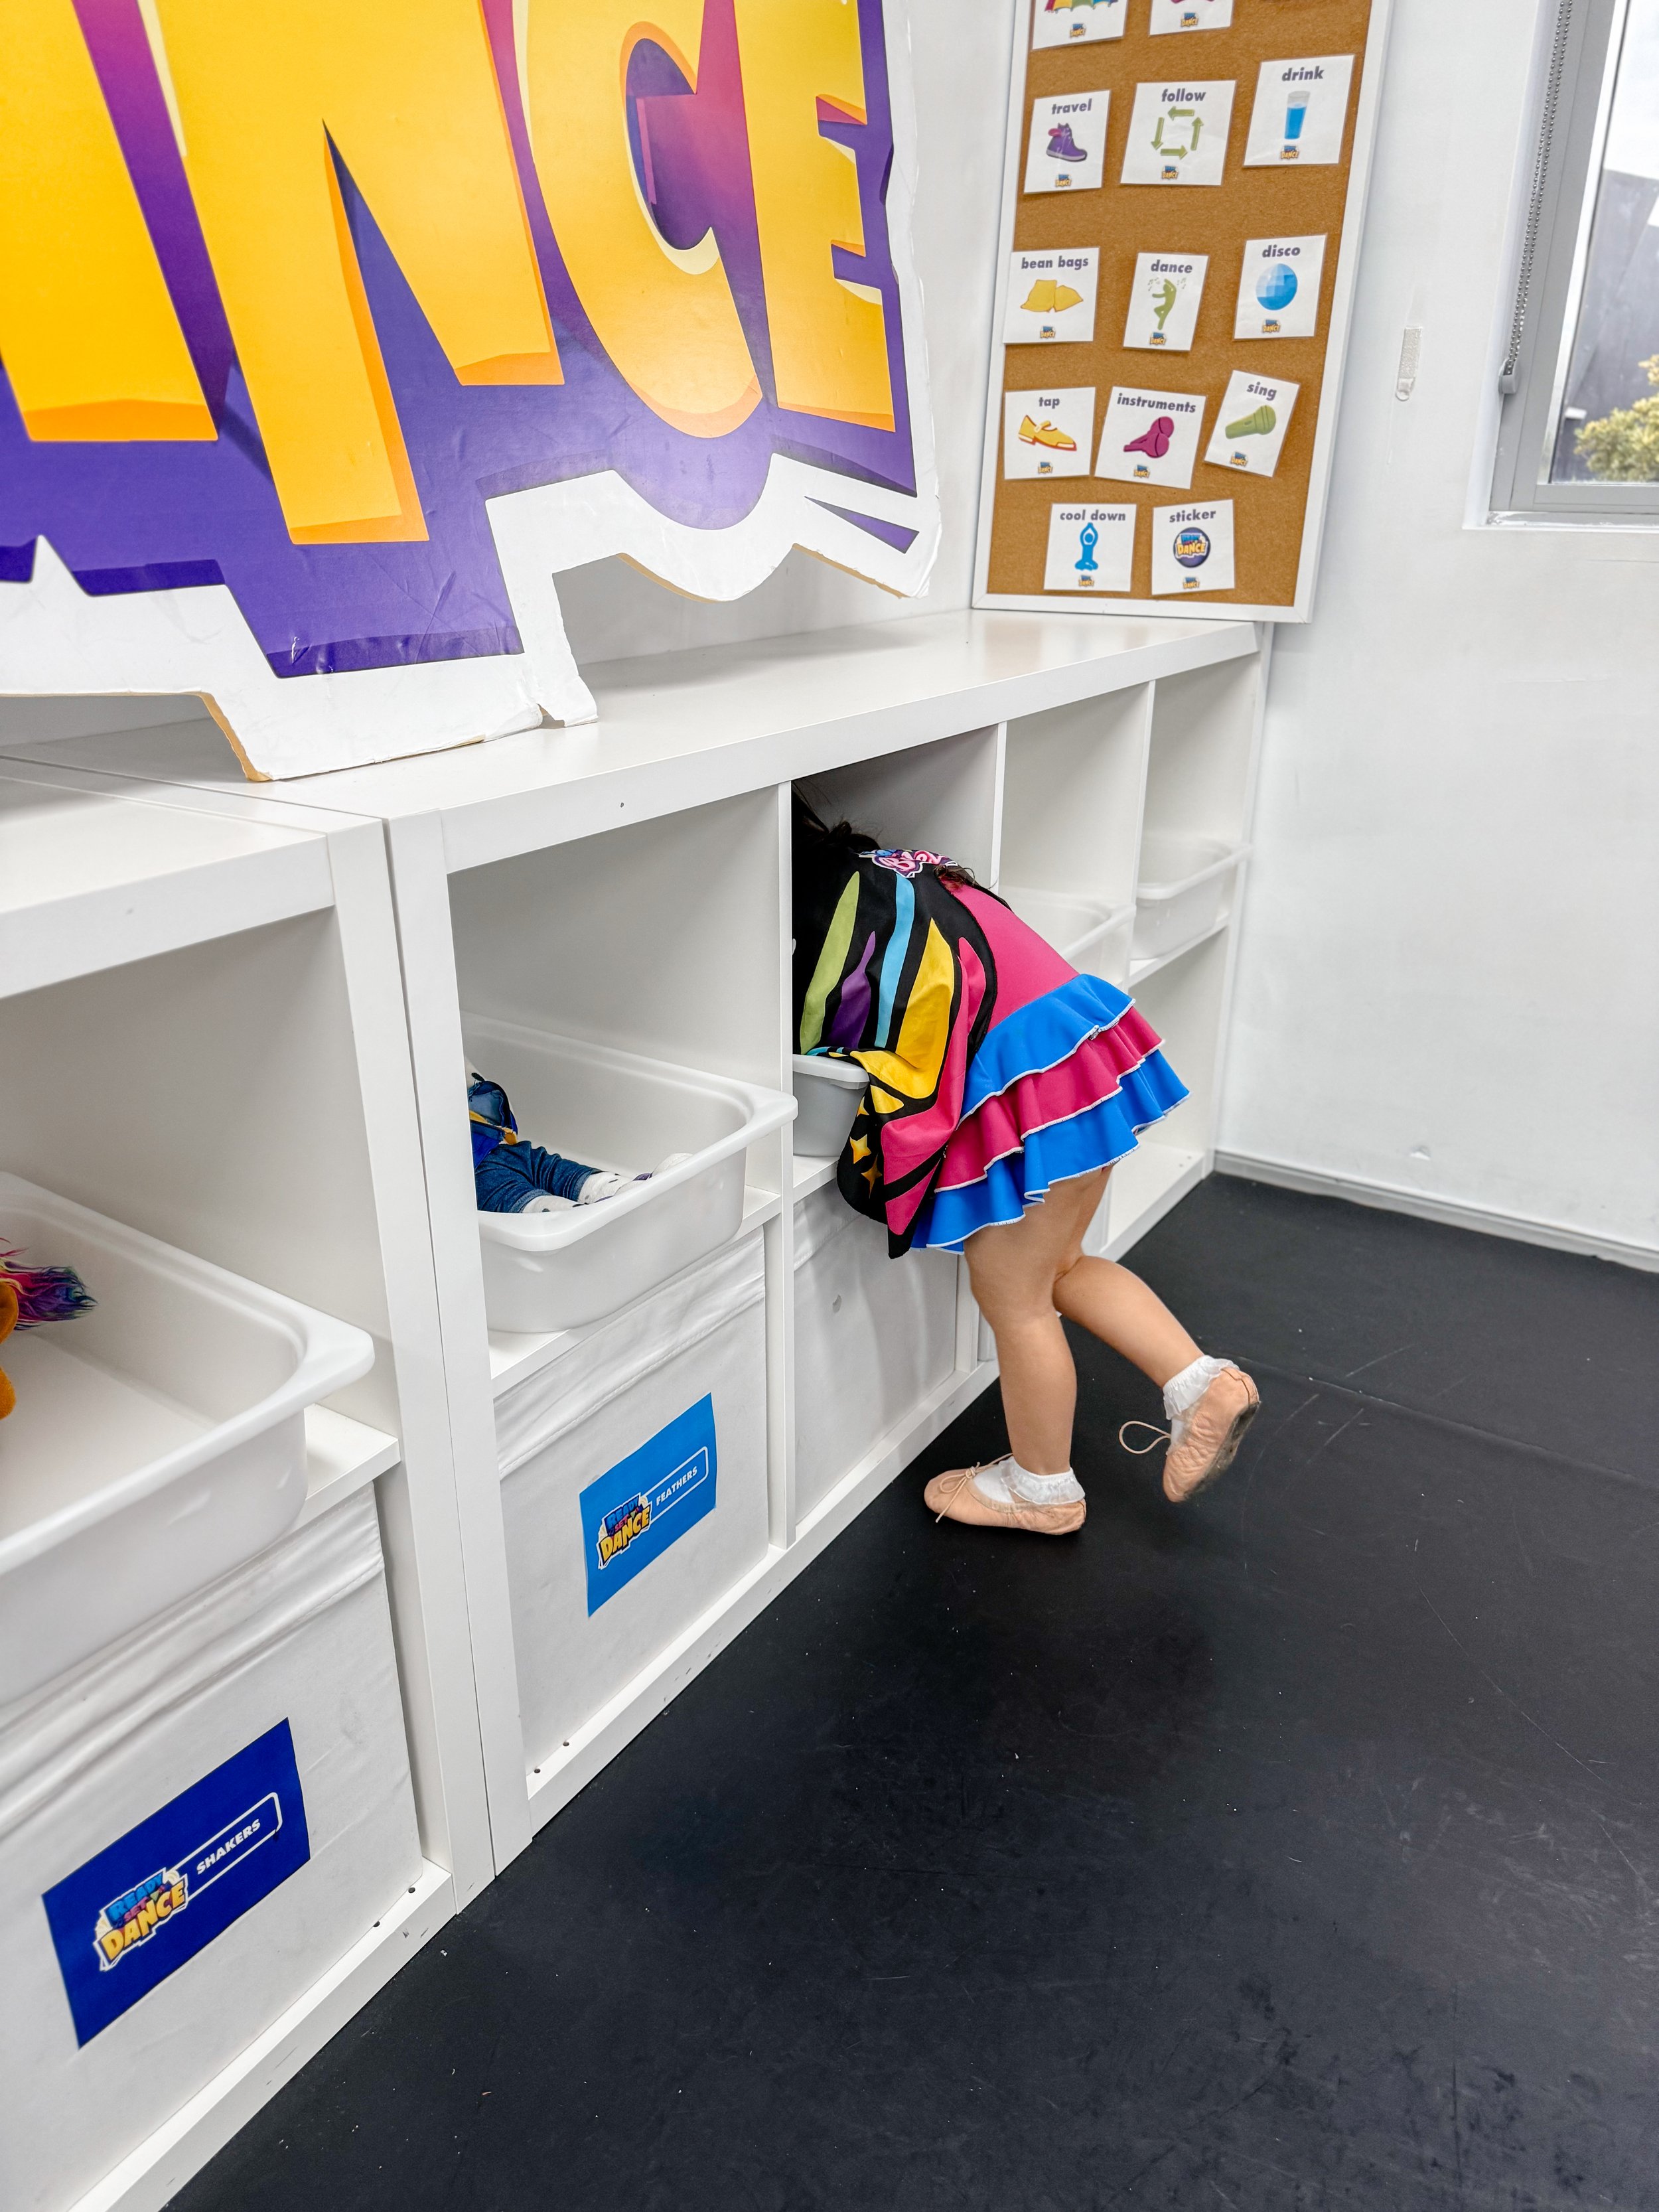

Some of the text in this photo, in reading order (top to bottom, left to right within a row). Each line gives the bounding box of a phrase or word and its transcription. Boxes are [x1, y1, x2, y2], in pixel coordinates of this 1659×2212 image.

[1281, 66, 1324, 82] drink
[1161, 88, 1206, 102] follow
[1052, 99, 1092, 115] travel
[1262, 245, 1301, 258] disco
[1021, 255, 1089, 271] bean bags
[1150, 259, 1193, 273] dance
[1246, 382, 1277, 401] sing
[1039, 397, 1060, 410] tap
[1117, 394, 1196, 413] instruments
[1060, 510, 1126, 521] cool down
[1169, 509, 1216, 523] sticker
[1177, 542, 1206, 555] DANCE
[656, 1465, 697, 1507] FEATHERS
[605, 1496, 639, 1529] READY
[599, 1505, 651, 1562] DANCE
[196, 1818, 261, 1875] SHAKERS
[106, 1872, 165, 1922] READY
[100, 1880, 186, 1961] DANCE
